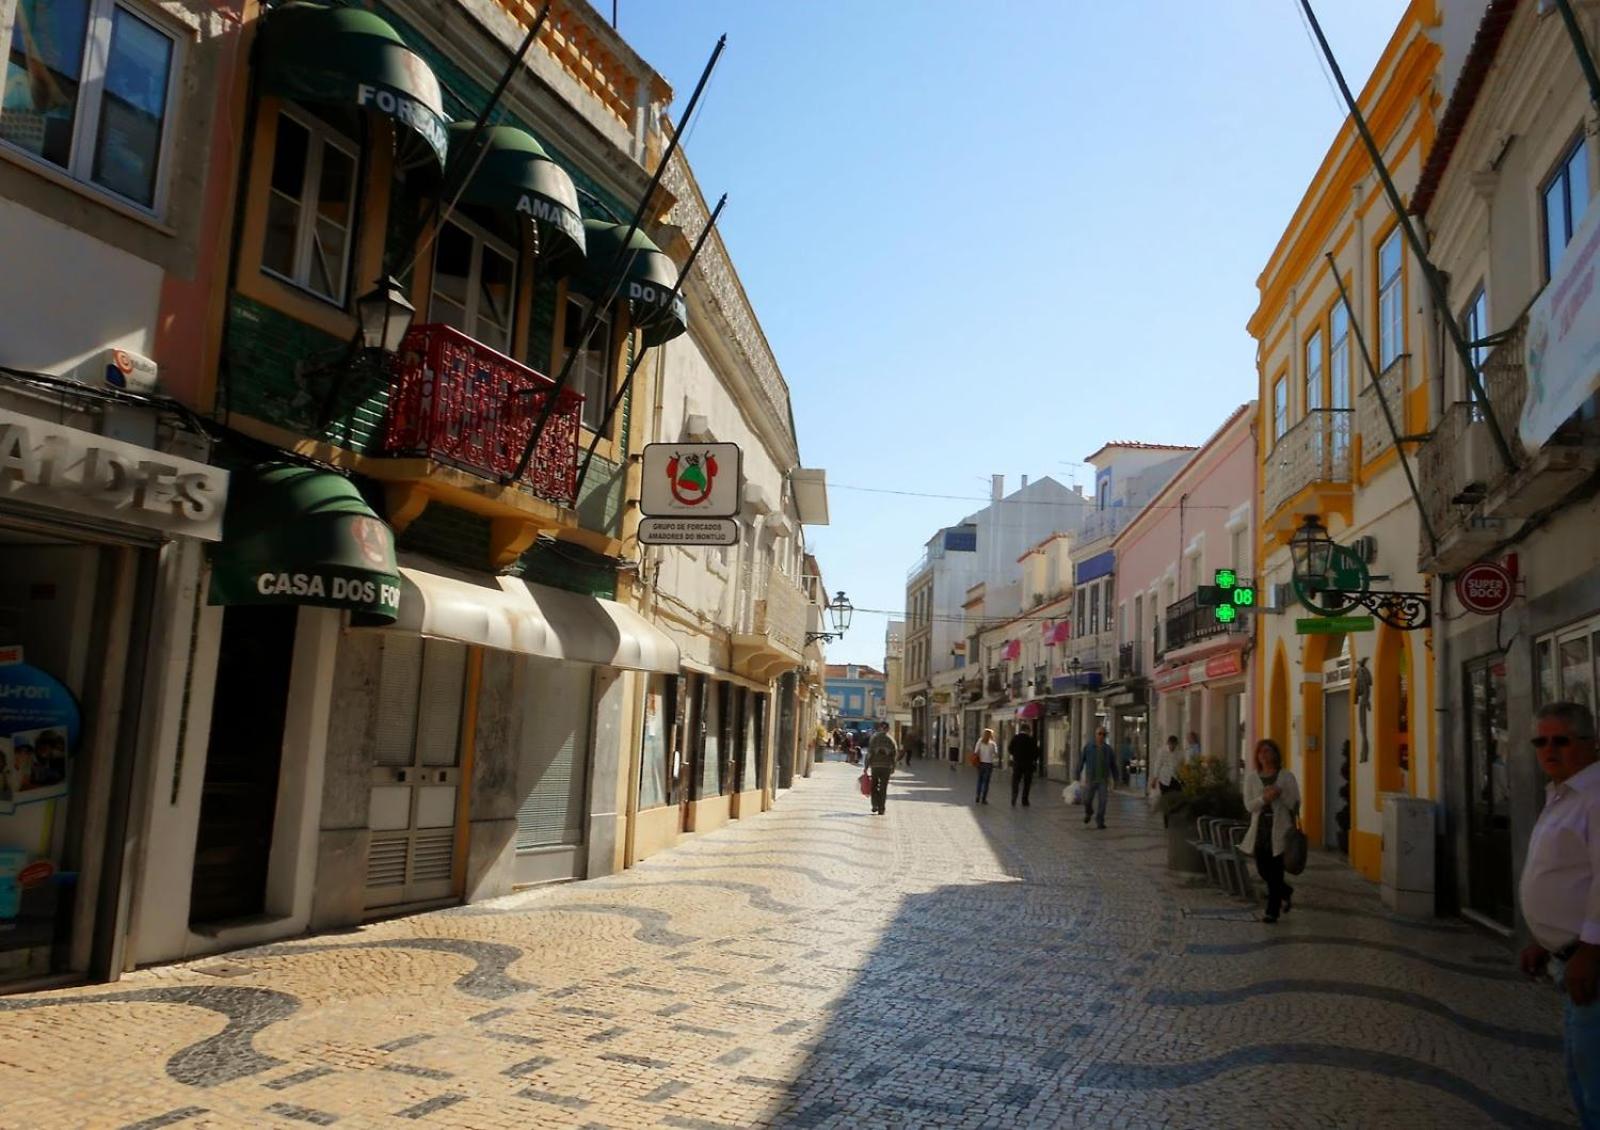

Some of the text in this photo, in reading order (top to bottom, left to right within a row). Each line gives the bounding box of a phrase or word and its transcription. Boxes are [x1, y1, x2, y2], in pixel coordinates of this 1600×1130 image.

[629, 281, 656, 303] DO
[687, 523, 722, 531] FORCADOS
[257, 572, 324, 596] CASA
[331, 576, 375, 604] DOS
[1467, 578, 1503, 589] SUPER
[1233, 588, 1253, 605] 08
[1469, 589, 1502, 599] BOCK
